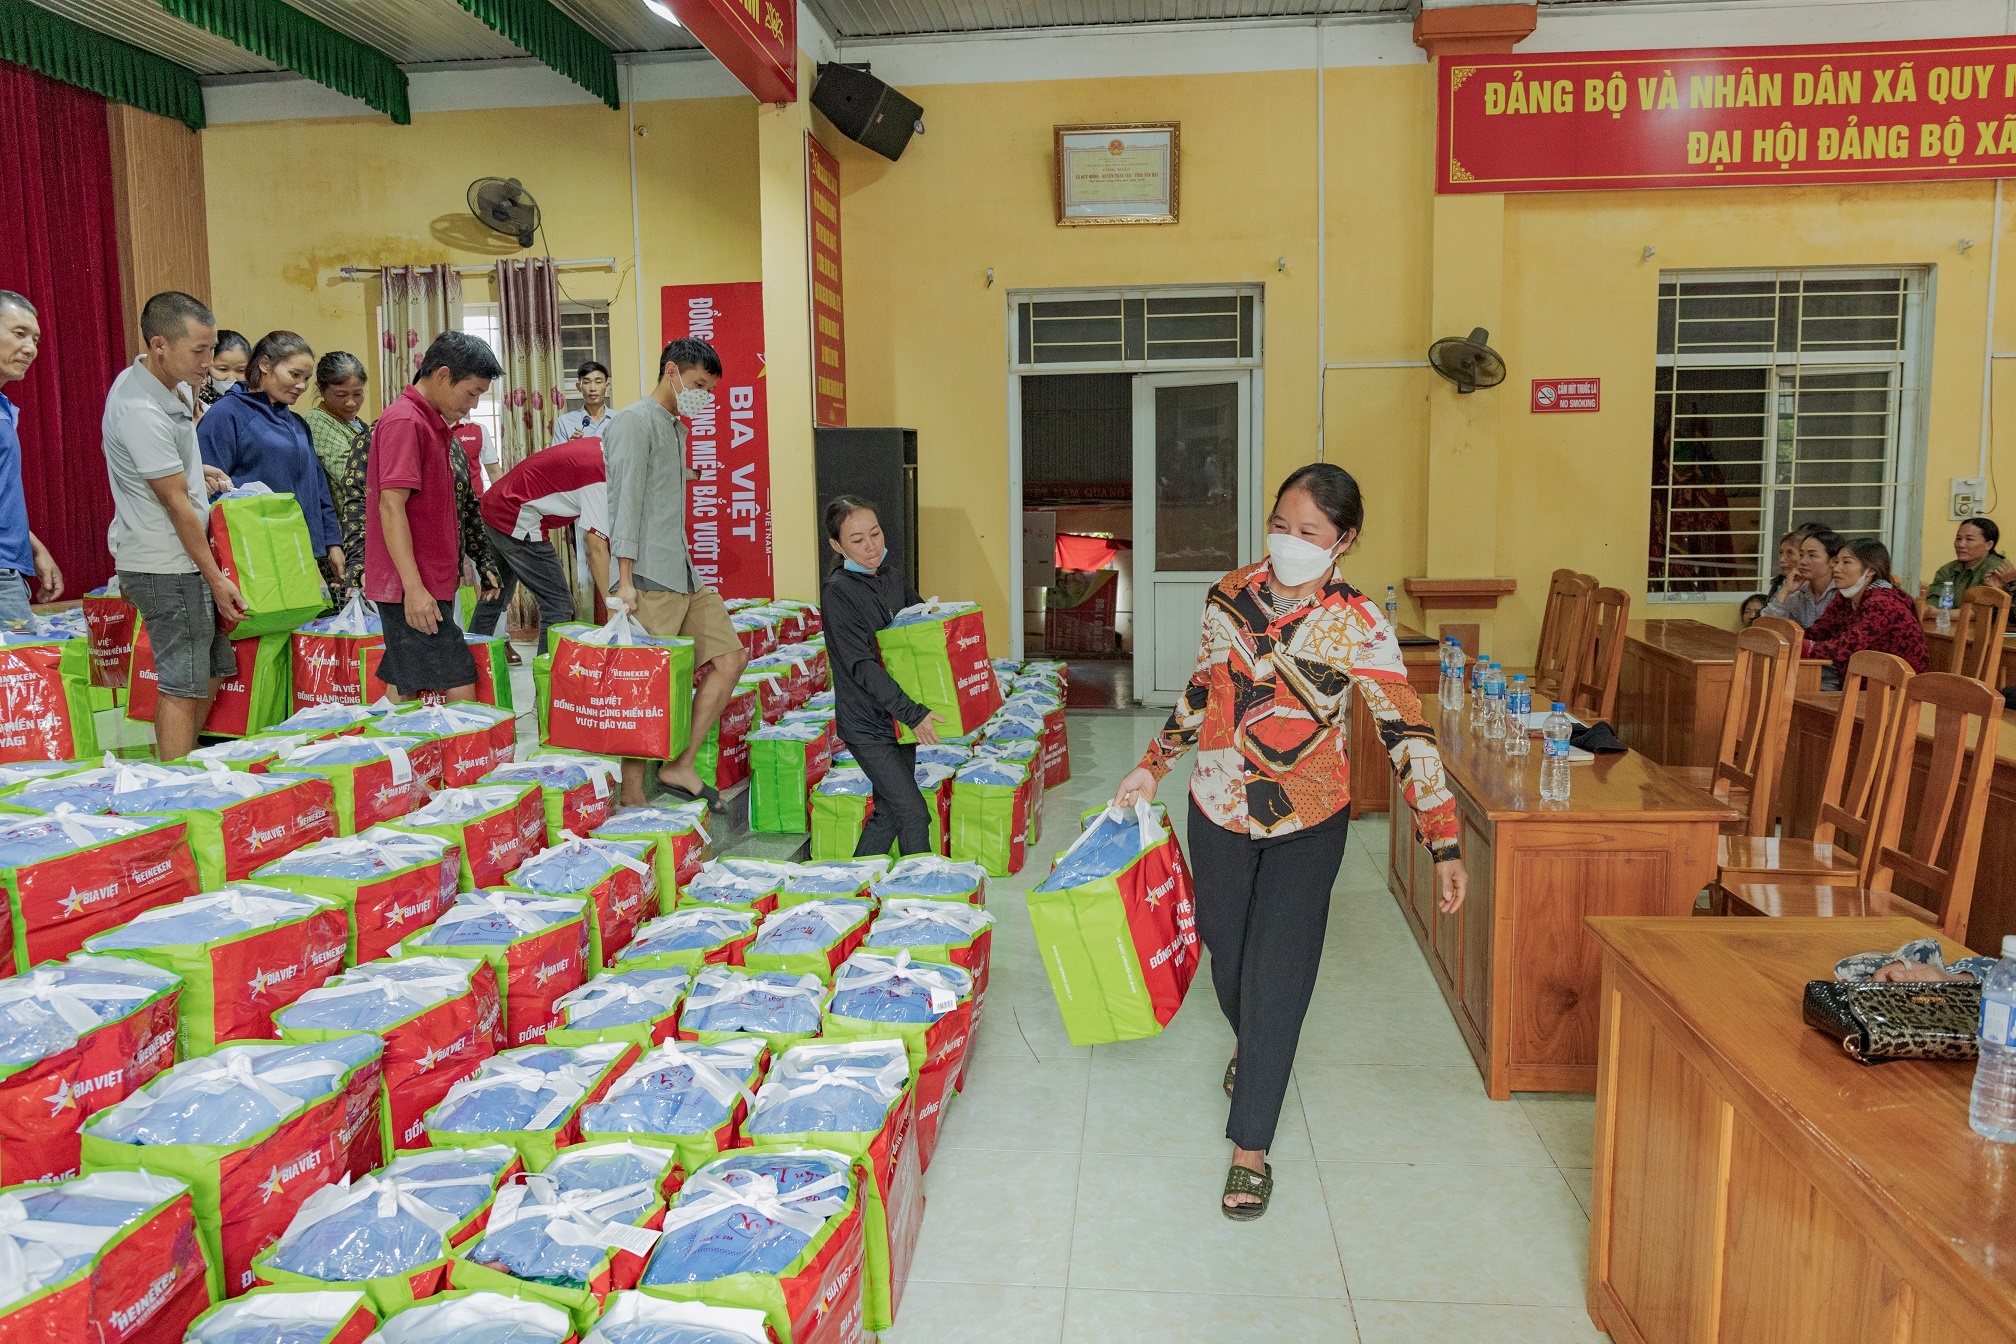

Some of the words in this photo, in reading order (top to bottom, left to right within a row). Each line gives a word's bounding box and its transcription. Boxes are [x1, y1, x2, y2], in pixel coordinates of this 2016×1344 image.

[1484, 70, 1573, 115] ĐẢNG
[1585, 71, 1627, 119] BỘ
[1638, 69, 1680, 111] VÀ
[1690, 67, 1781, 109] NHÂN
[1793, 65, 1861, 106] DÂN
[1871, 61, 1917, 103] XÃ
[1927, 64, 1994, 101] QUY
[1687, 130, 1742, 171] ĐẠI
[1753, 122, 1807, 169] HỘI
[1817, 115, 1908, 161] ĐẢNG
[1920, 116, 1965, 163] BỘ
[1975, 114, 2016, 155] XÃ
[729, 386, 755, 449] BIA
[1559, 399, 1569, 408] NO
[1570, 399, 1596, 408] SMOKING
[691, 440, 725, 480] MIỀN
[692, 485, 727, 516] BẮC
[726, 462, 761, 542] VIỆT
[764, 511, 773, 554] VIETNAM
[139, 668, 159, 681] ĐỒNG
[227, 680, 245, 694] BẮC
[553, 699, 575, 712] ĐỒNG
[576, 705, 598, 717] HÀNH
[599, 707, 620, 718] CÙNG
[622, 706, 644, 718] MIỀN
[645, 705, 664, 718] BẮC
[575, 716, 598, 729] VƯỢT
[616, 721, 636, 730] YAGI
[83, 890, 100, 905] BIA
[98, 883, 119, 899] VIỆT
[135, 860, 173, 884] HEINEKEN
[1149, 945, 1173, 970] ĐỒNG
[519, 1024, 546, 1043] ĐỒNG
[73, 1078, 95, 1099] BIA
[94, 1069, 124, 1088] VIỆT
[404, 1118, 427, 1143] ĐỒN
[281, 1162, 301, 1183] BIA
[298, 1149, 322, 1170] VIỆT
[117, 1267, 177, 1331] HEINEKEN
